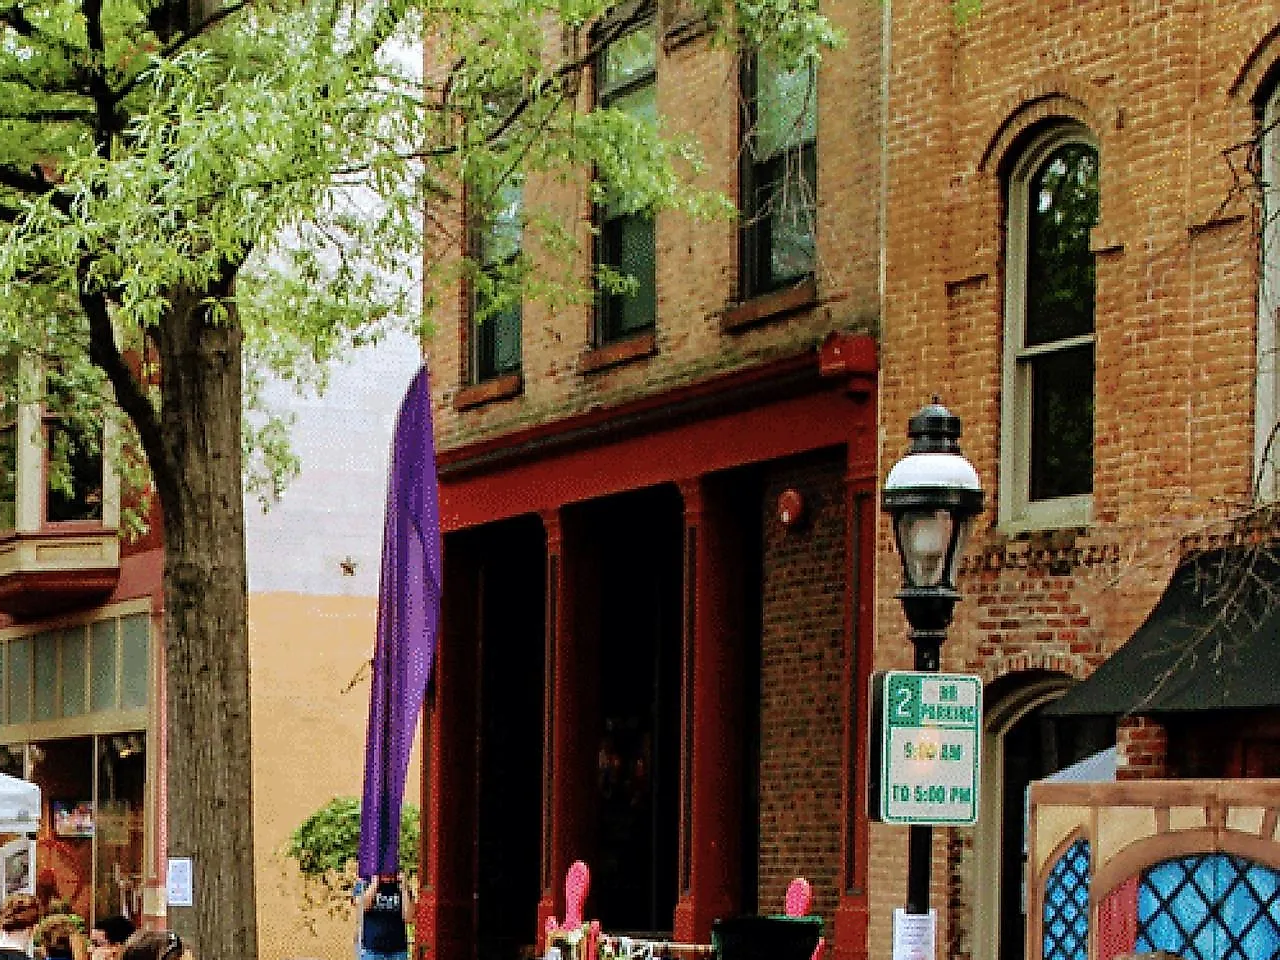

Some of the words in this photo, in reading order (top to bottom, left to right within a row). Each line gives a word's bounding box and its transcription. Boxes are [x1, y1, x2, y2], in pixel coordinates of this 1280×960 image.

[896, 687, 913, 718] 2
[920, 704, 976, 721] PARKING
[940, 743, 962, 760] AM
[892, 785, 910, 802] TO
[914, 785, 946, 804] 5:00
[949, 786, 971, 804] PM
